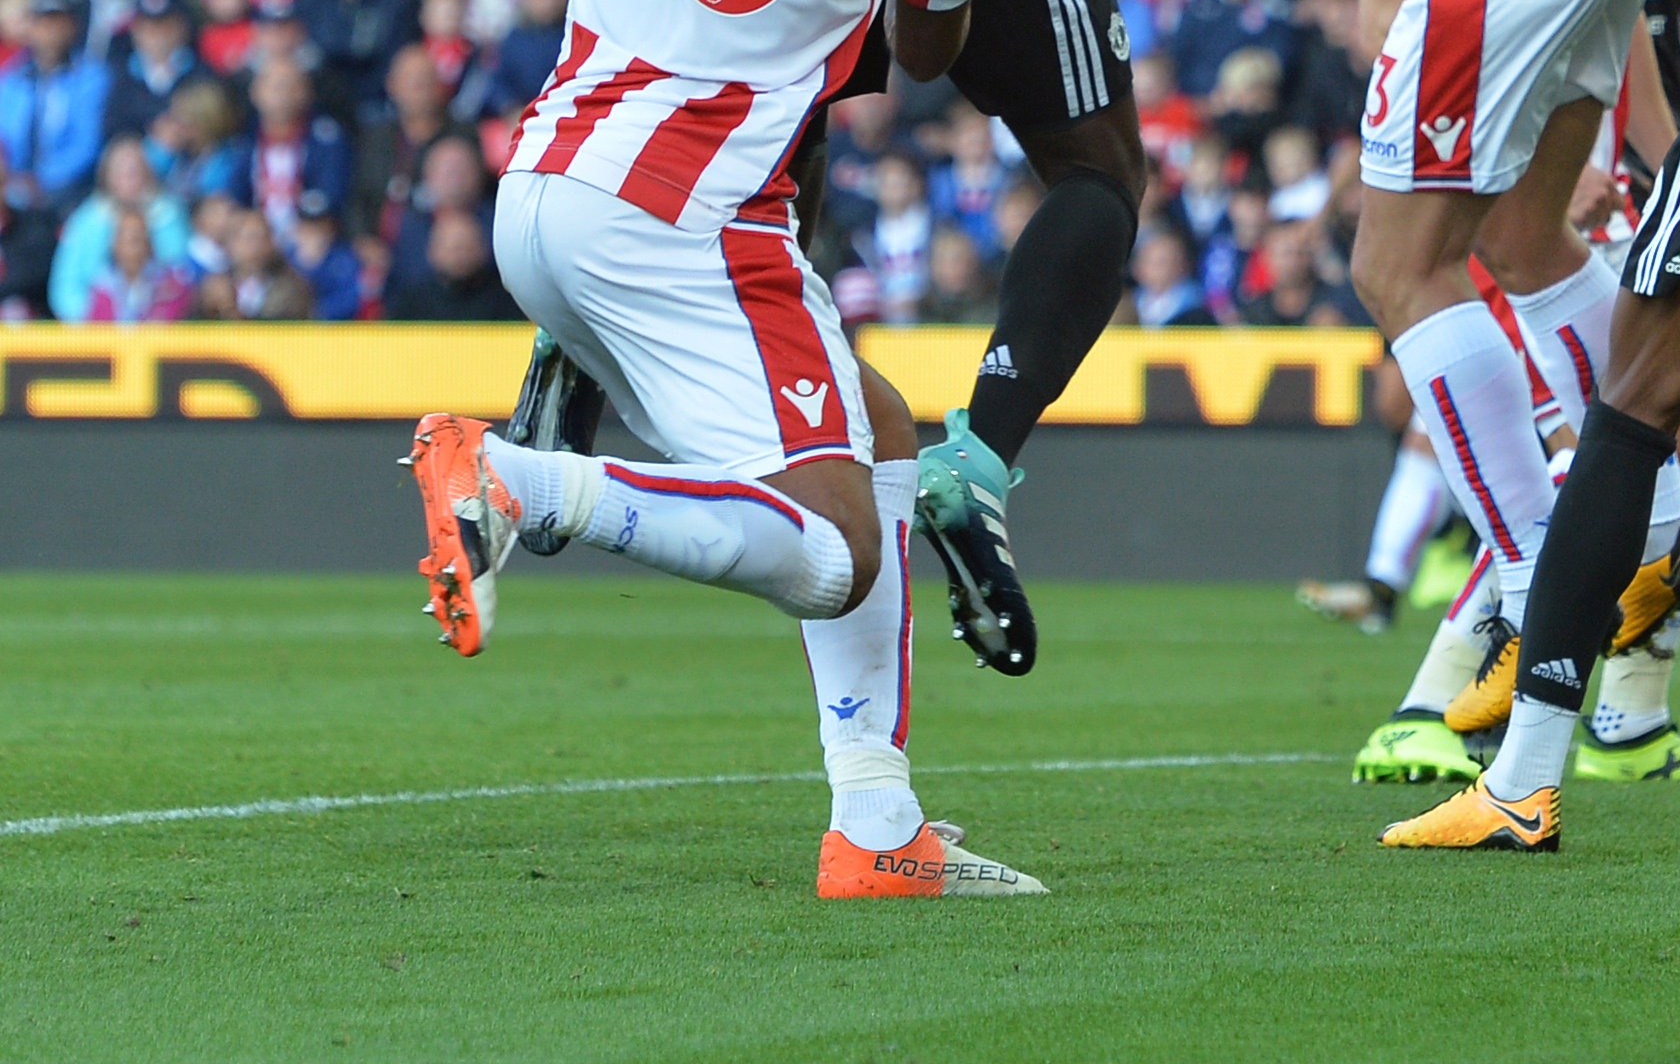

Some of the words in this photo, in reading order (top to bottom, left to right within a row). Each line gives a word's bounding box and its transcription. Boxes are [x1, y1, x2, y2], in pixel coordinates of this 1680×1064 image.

[1367, 53, 1398, 128] 3
[1530, 665, 1582, 690] adidas
[873, 853, 1019, 886] EVOSPEED
